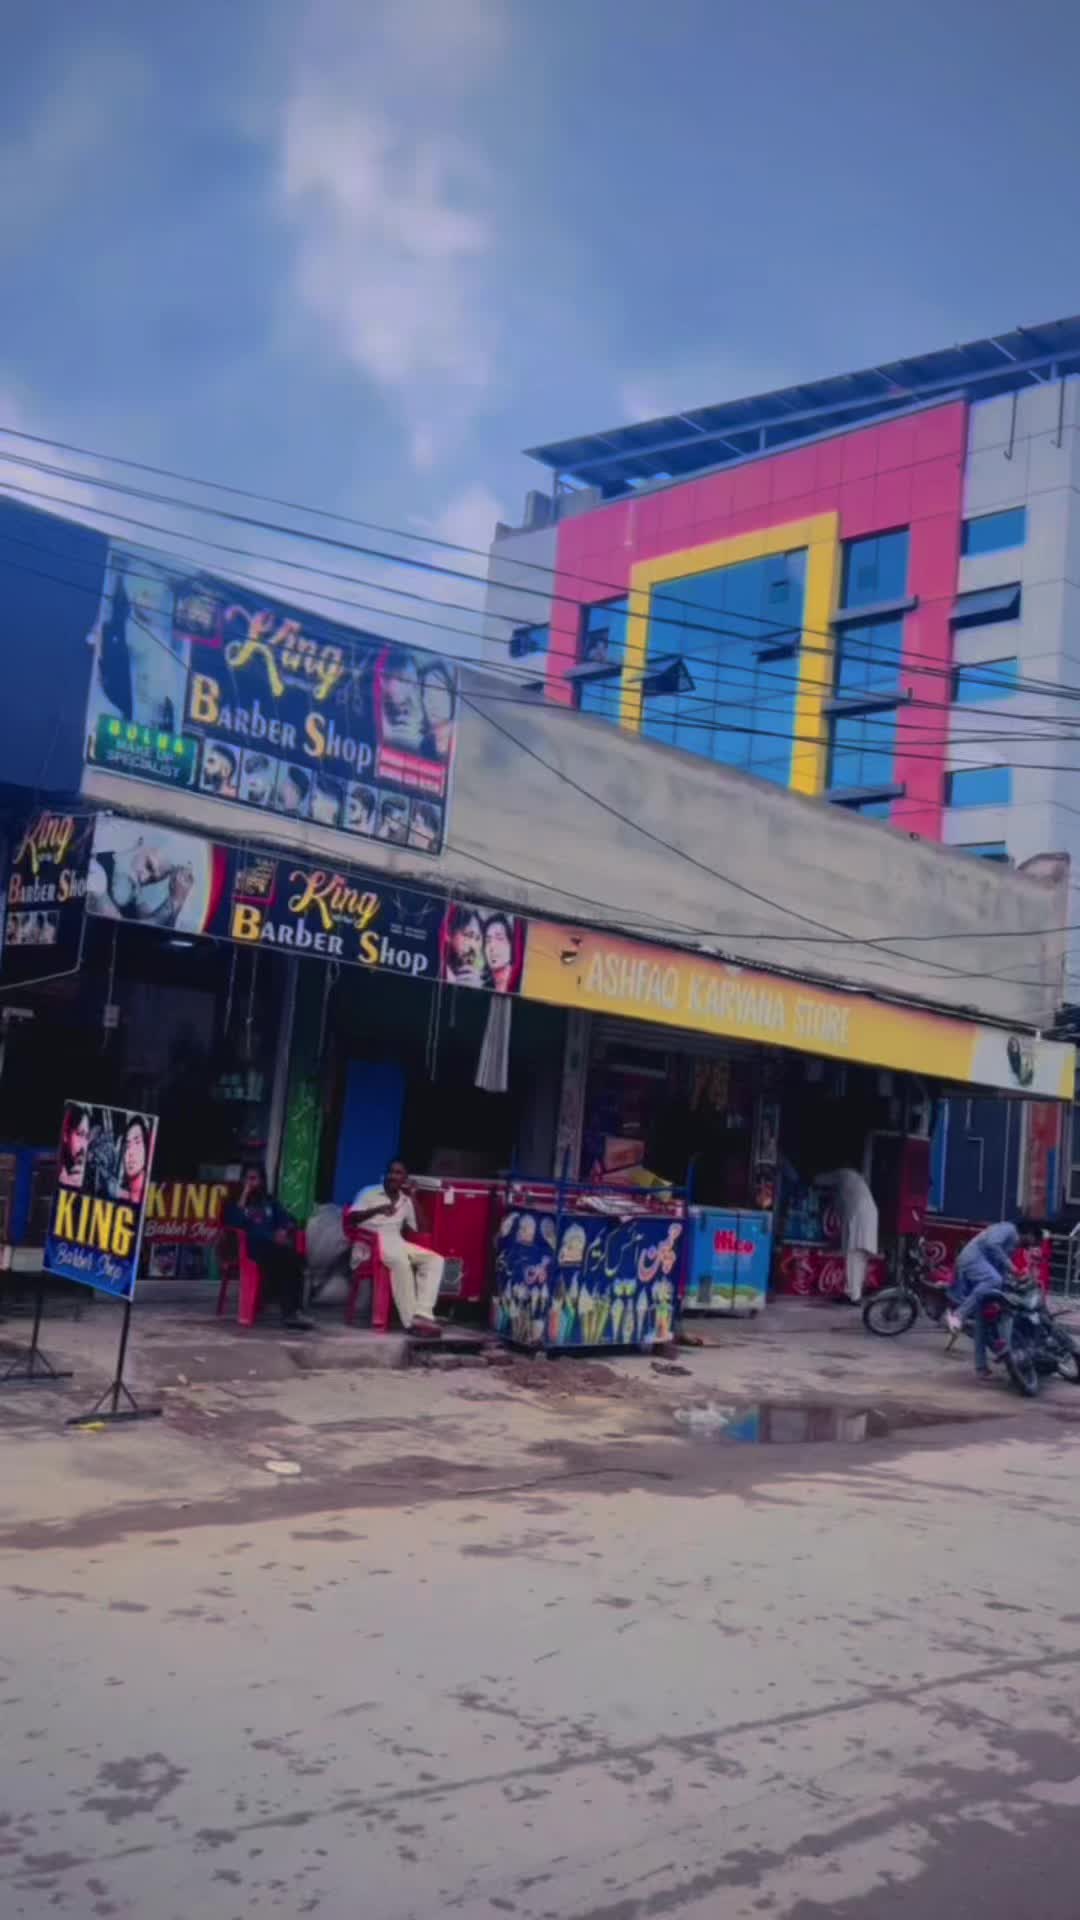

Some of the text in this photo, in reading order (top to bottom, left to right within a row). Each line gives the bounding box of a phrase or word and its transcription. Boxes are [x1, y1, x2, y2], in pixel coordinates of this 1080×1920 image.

[224, 605, 345, 700] King
[288, 869, 381, 931] King
[586, 951, 851, 1047] ASHFAQ KARYANA STORE
[54, 1189, 135, 1257] KING
